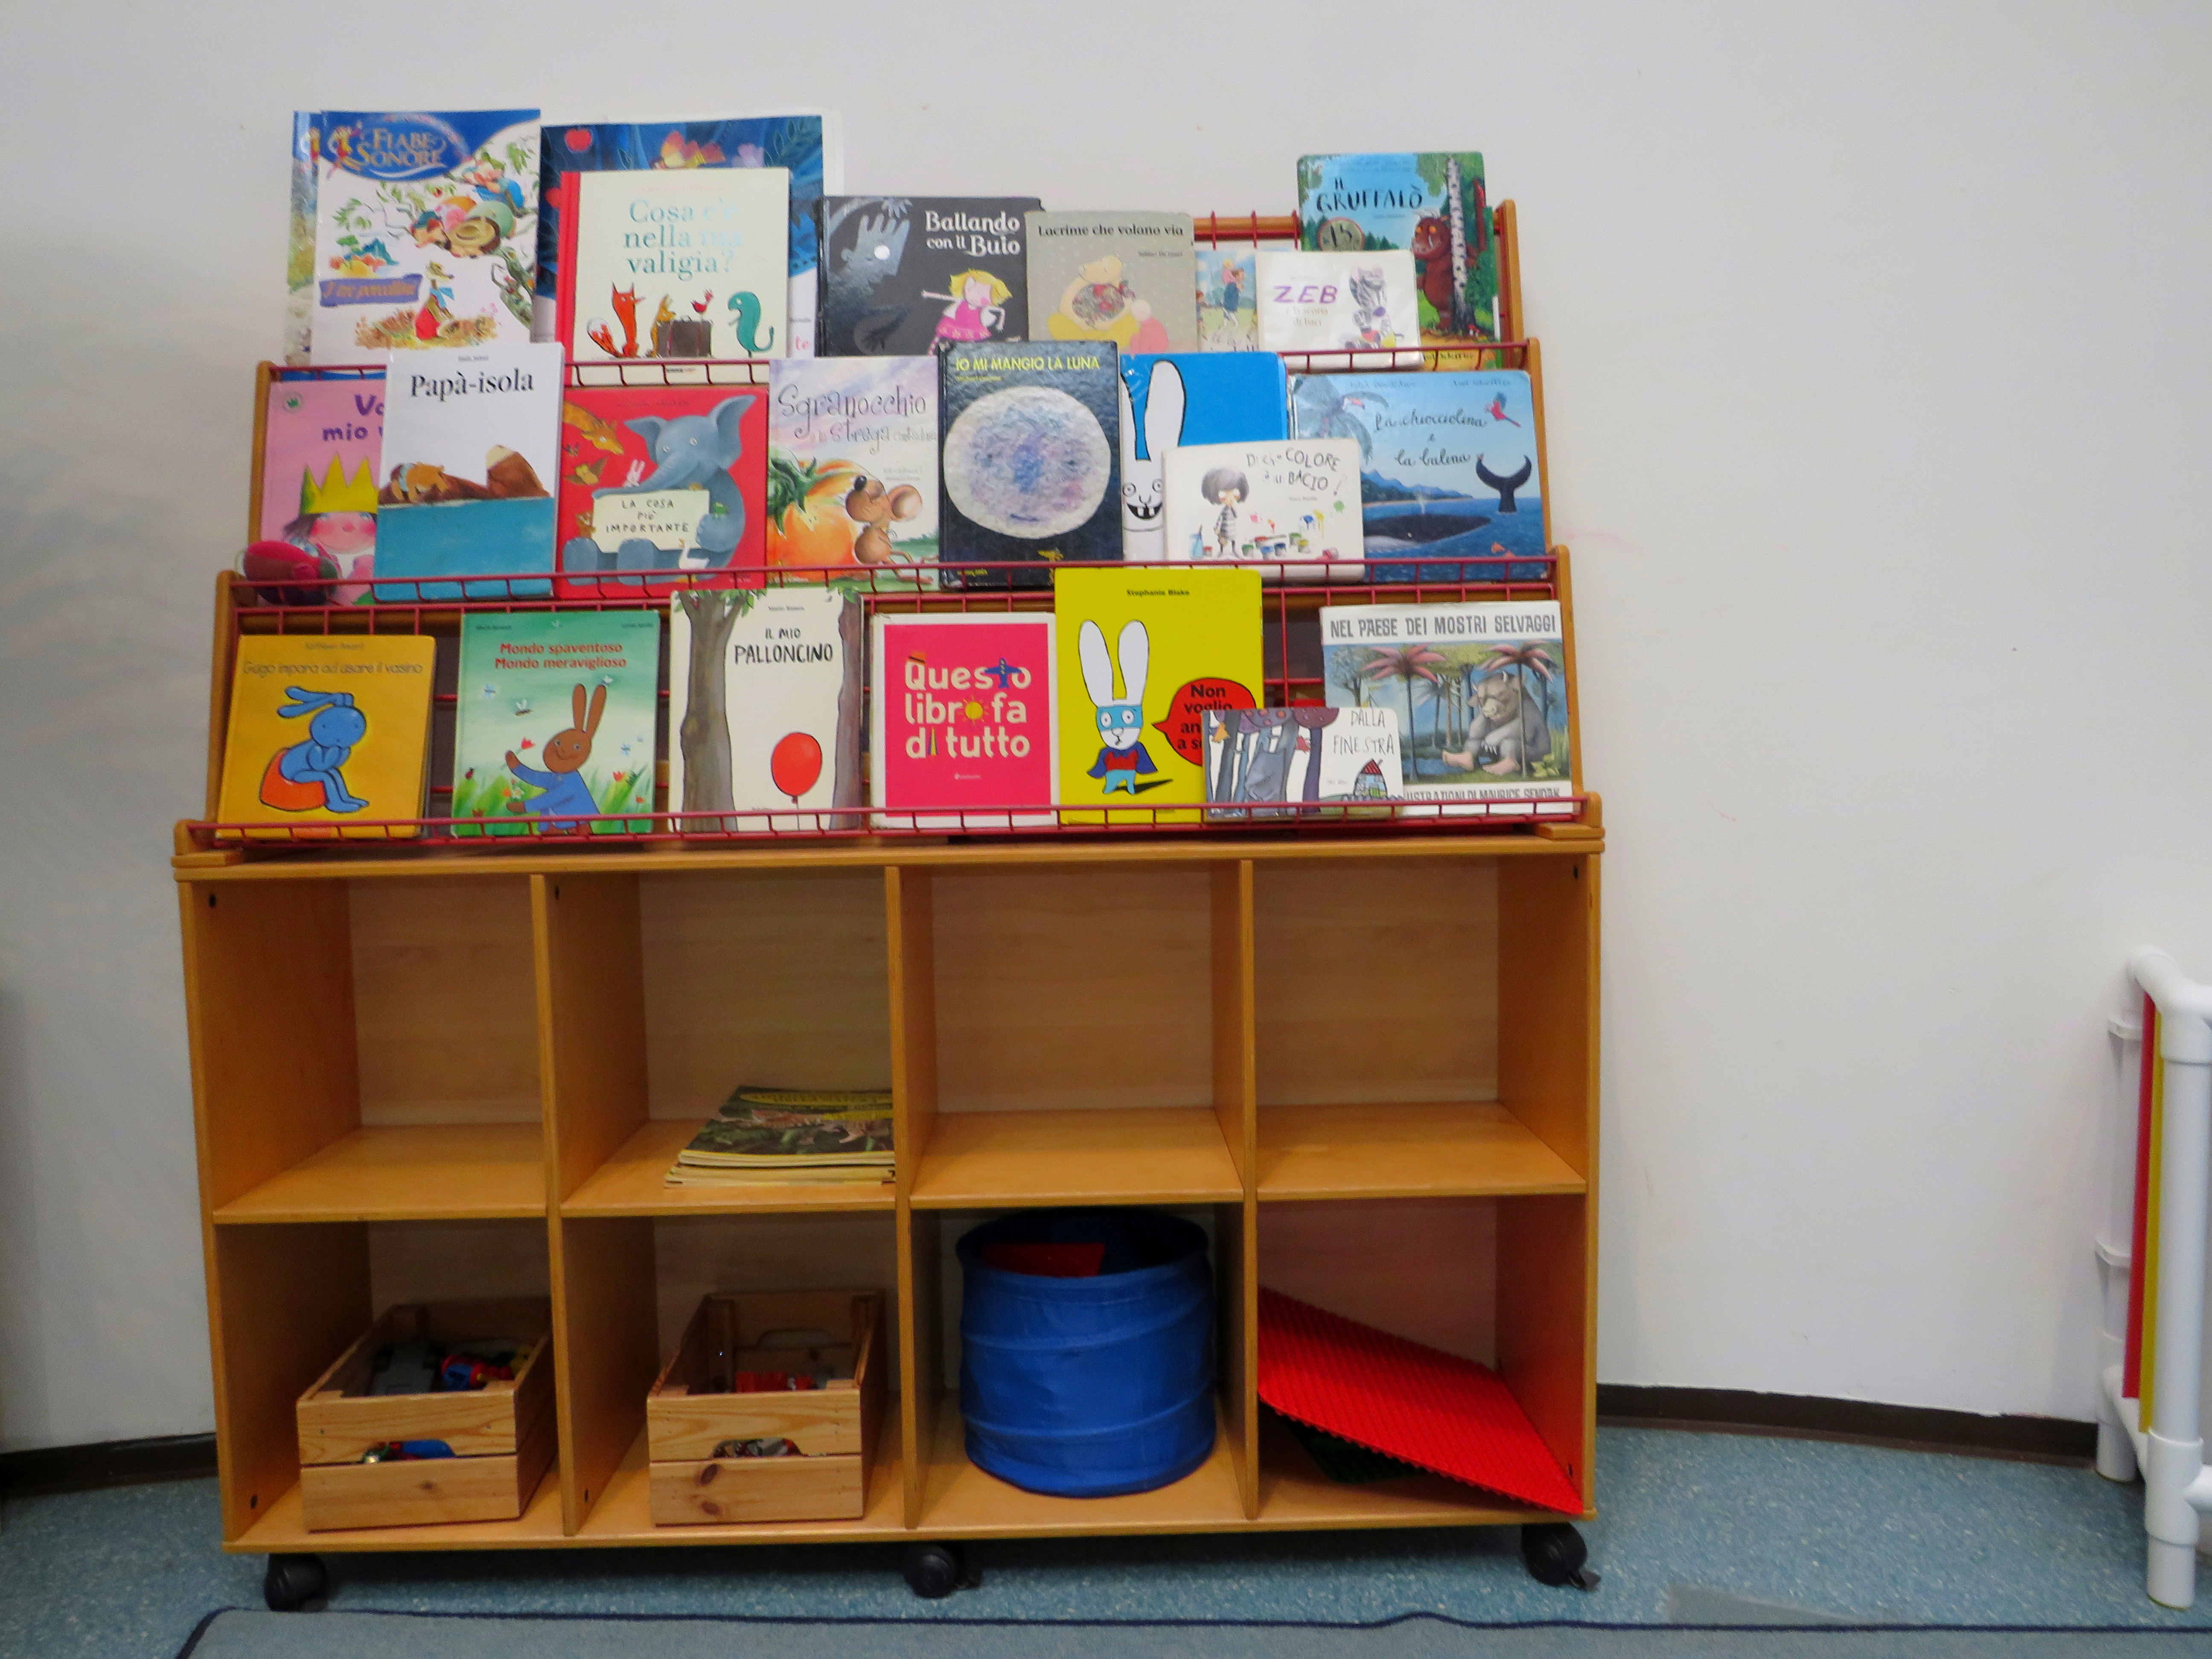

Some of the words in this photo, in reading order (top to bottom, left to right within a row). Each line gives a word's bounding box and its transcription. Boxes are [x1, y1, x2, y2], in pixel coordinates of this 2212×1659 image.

[373, 128, 433, 149] FIABE
[358, 141, 442, 167] SONORE
[629, 198, 695, 224] Cosa
[703, 196, 739, 222] c'è
[925, 210, 1021, 235] Ballando
[1038, 224, 1089, 237] Lacrime
[1092, 224, 1115, 236] che
[1118, 223, 1161, 236] volano
[1164, 224, 1184, 236] via
[623, 223, 691, 249] nella
[700, 227, 742, 247] tua
[926, 237, 953, 250] con
[627, 248, 734, 282] valigia?
[1273, 285, 1338, 304] ZEB
[955, 357, 970, 371] IO
[973, 357, 988, 371] MI
[990, 356, 1045, 371] MANGIO
[1048, 356, 1064, 370] LA
[1066, 355, 1101, 370] LUNA
[410, 366, 535, 402] Papà-isola
[777, 383, 926, 439] Sgranocchio
[322, 422, 368, 442] mio
[1285, 447, 1341, 472] COLORE
[1419, 447, 1471, 466] balena
[621, 499, 637, 510] LA
[646, 498, 674, 509] COSA
[605, 521, 690, 533] IMPORTANTE
[1126, 588, 1166, 598] Stephanie
[765, 627, 774, 640] IL
[778, 627, 802, 640] MIO
[1330, 619, 1354, 638] NEL
[1358, 617, 1399, 637] PAESE
[1405, 617, 1428, 636] DEI
[1434, 615, 1487, 635] MOSTRI
[1494, 614, 1557, 634] SELVAGGI
[500, 642, 545, 655] Mondo
[548, 642, 623, 656] spaventoso
[734, 642, 834, 665] PALLONCINO
[494, 657, 539, 669] Mondo
[543, 656, 627, 671] meraviglioso
[1190, 684, 1226, 698] Non
[991, 691, 1027, 724] fa
[1351, 707, 1385, 728] DALLA
[945, 726, 1030, 759] tutto
[1177, 739, 1187, 750] a
[1333, 733, 1395, 756] FINESTRA
[1406, 790, 1465, 801] USTRAZIONI
